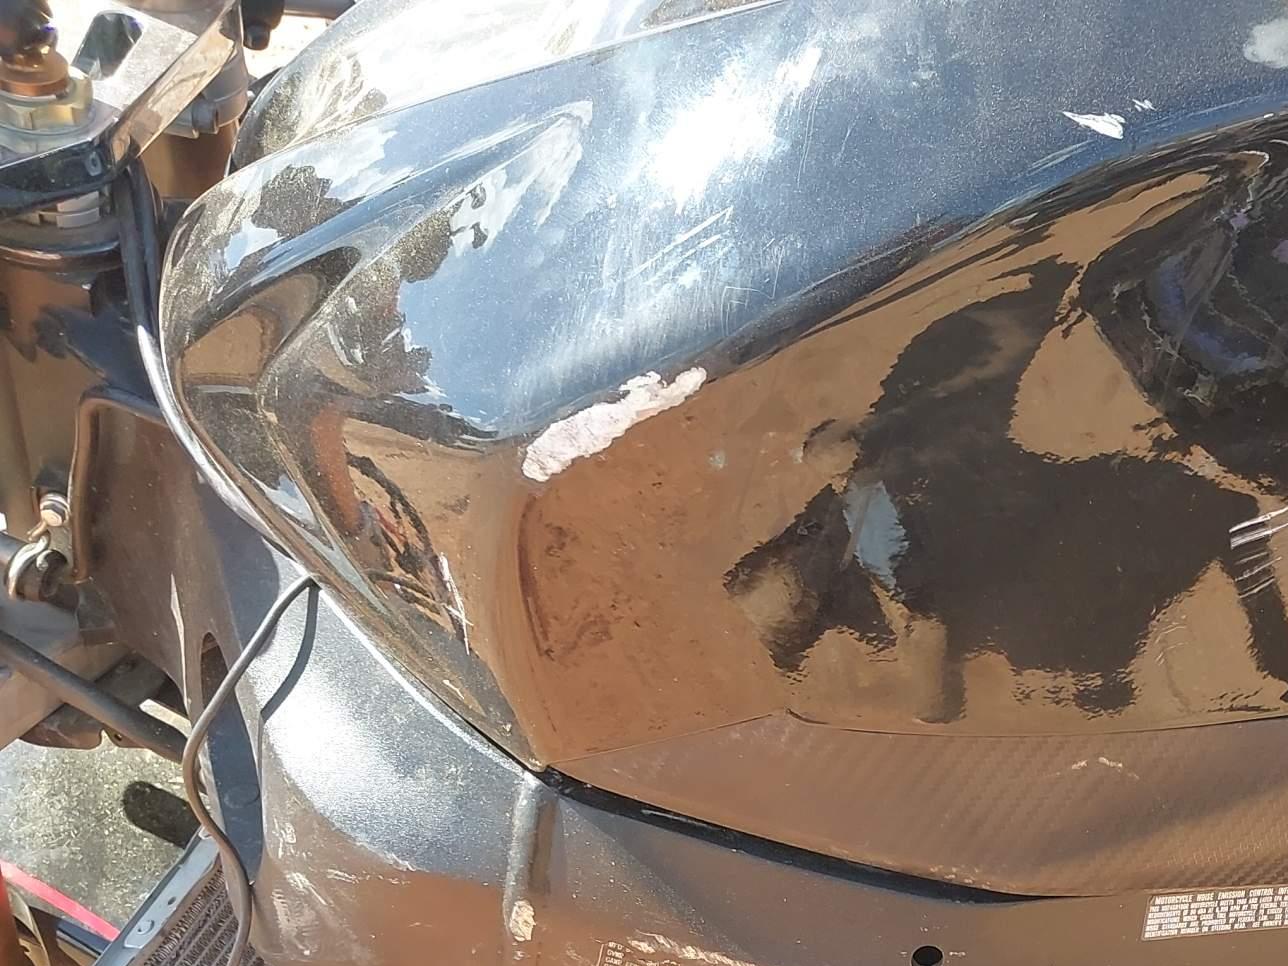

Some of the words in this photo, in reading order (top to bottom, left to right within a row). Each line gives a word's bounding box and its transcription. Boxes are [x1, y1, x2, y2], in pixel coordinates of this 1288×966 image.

[1154, 893, 1193, 905] MOTORCYCLE
[1196, 892, 1214, 901] NOISE
[1217, 889, 1245, 900] EMISSION
[1249, 887, 1274, 897] CONTROL
